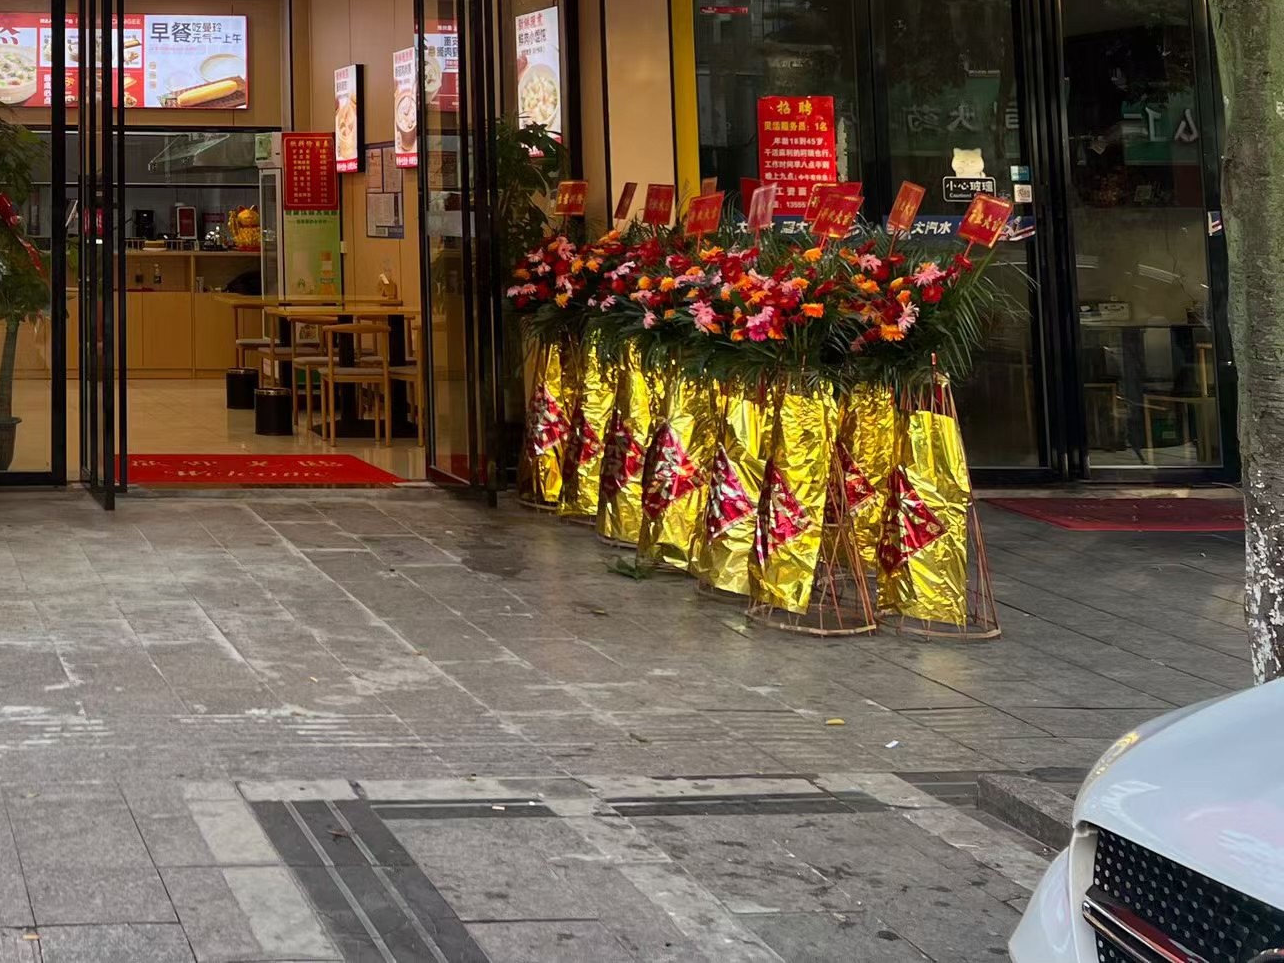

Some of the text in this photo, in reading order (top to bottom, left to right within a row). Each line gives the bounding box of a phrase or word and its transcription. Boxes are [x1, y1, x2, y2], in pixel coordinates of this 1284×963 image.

[150, 22, 192, 43] 早餐
[192, 22, 223, 33] 吃曼玲
[192, 32, 243, 45] 元气一上午
[776, 100, 813, 115] 招聘
[946, 180, 994, 192] 小心玻璃
